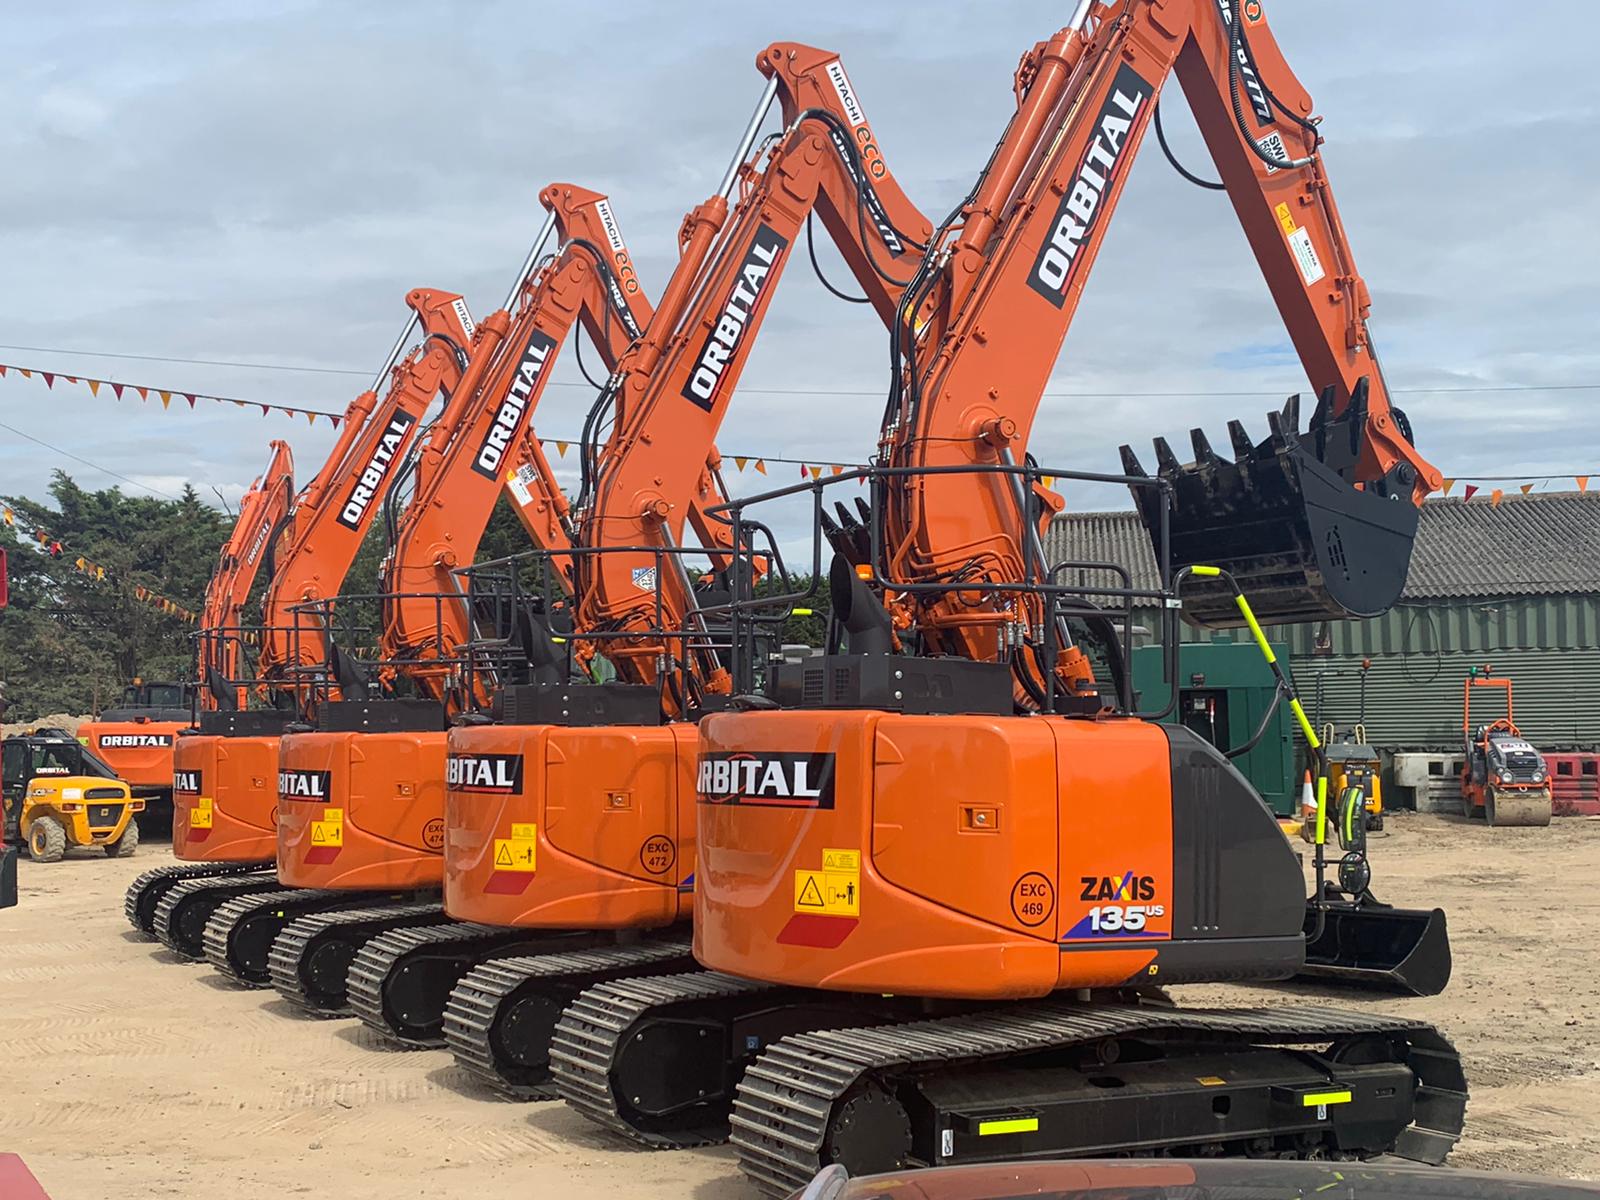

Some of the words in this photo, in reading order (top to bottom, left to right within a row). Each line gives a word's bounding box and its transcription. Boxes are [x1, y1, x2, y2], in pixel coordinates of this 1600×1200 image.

[830, 66, 860, 121] HITACHI
[1039, 88, 1143, 290] ORBITAL
[599, 203, 621, 248] HITACHI
[615, 251, 639, 293] eco
[456, 302, 474, 337] HITACH
[691, 244, 779, 400] ORBITAL
[478, 344, 550, 472] ORBITAL
[342, 420, 410, 524] ORBITAL
[101, 736, 169, 747] ORBITAL
[446, 758, 514, 786] BITAL
[697, 760, 821, 797] RBITAL
[647, 842, 669, 853] EXC
[648, 856, 667, 866] 472
[1020, 883, 1047, 897] EXC
[1080, 870, 1155, 901] ZAXIS
[1022, 902, 1043, 916] 469
